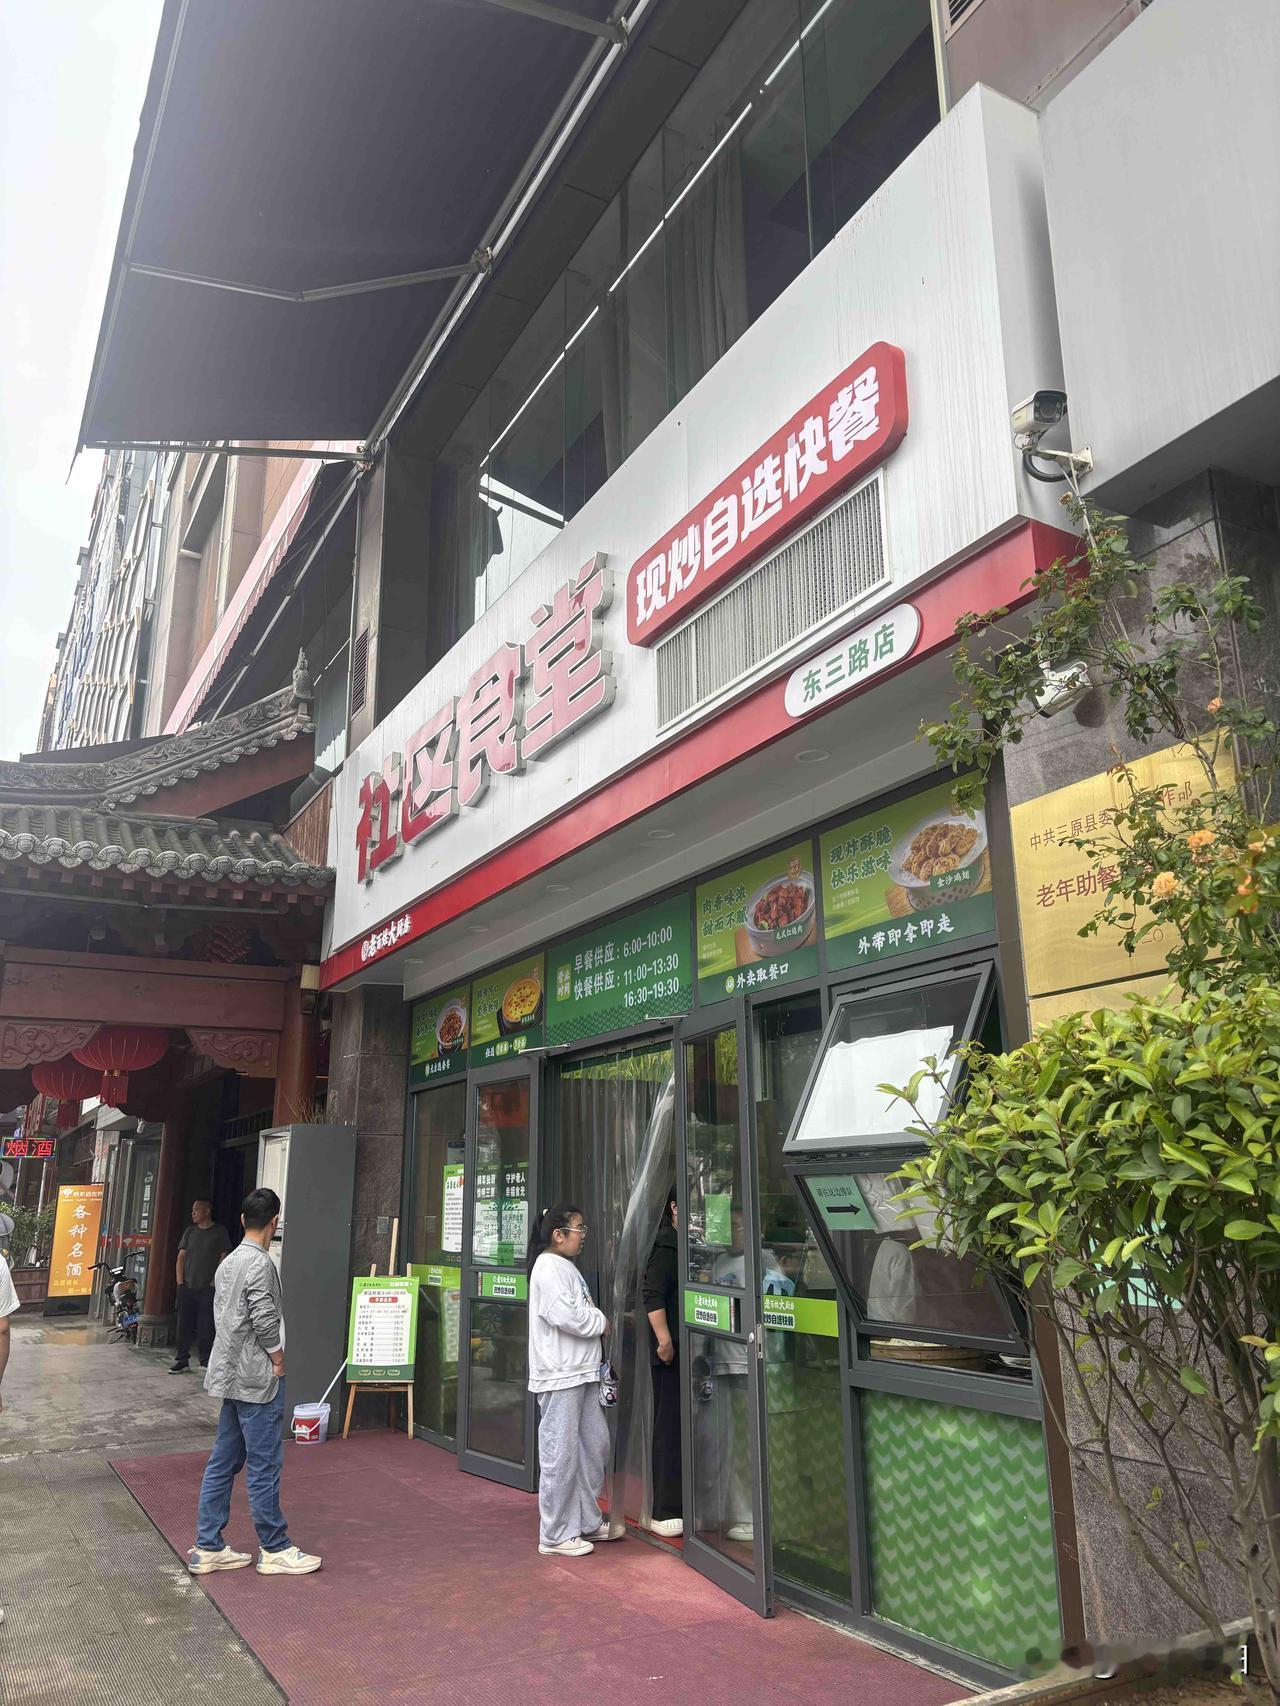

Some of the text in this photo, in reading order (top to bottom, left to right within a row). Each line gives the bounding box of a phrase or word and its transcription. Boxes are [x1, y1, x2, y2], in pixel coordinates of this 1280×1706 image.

[636, 366, 880, 627] 现炒自选快餐
[802, 622, 895, 703] 东三路店
[356, 551, 611, 886] 社区食堂
[829, 824, 893, 864] 现炸酥脆
[829, 849, 893, 889] 快乐滋味
[937, 871, 971, 888] 金沙鸡翅
[702, 884, 747, 914] 肉香味浓
[858, 913, 955, 955] 外带即拿即走
[624, 977, 680, 1008] 16:30-19:30
[736, 963, 789, 989] 外卖取餐口
[6, 1140, 53, 1156] 烟酒
[66, 1204, 91, 1276] 各种名酒
